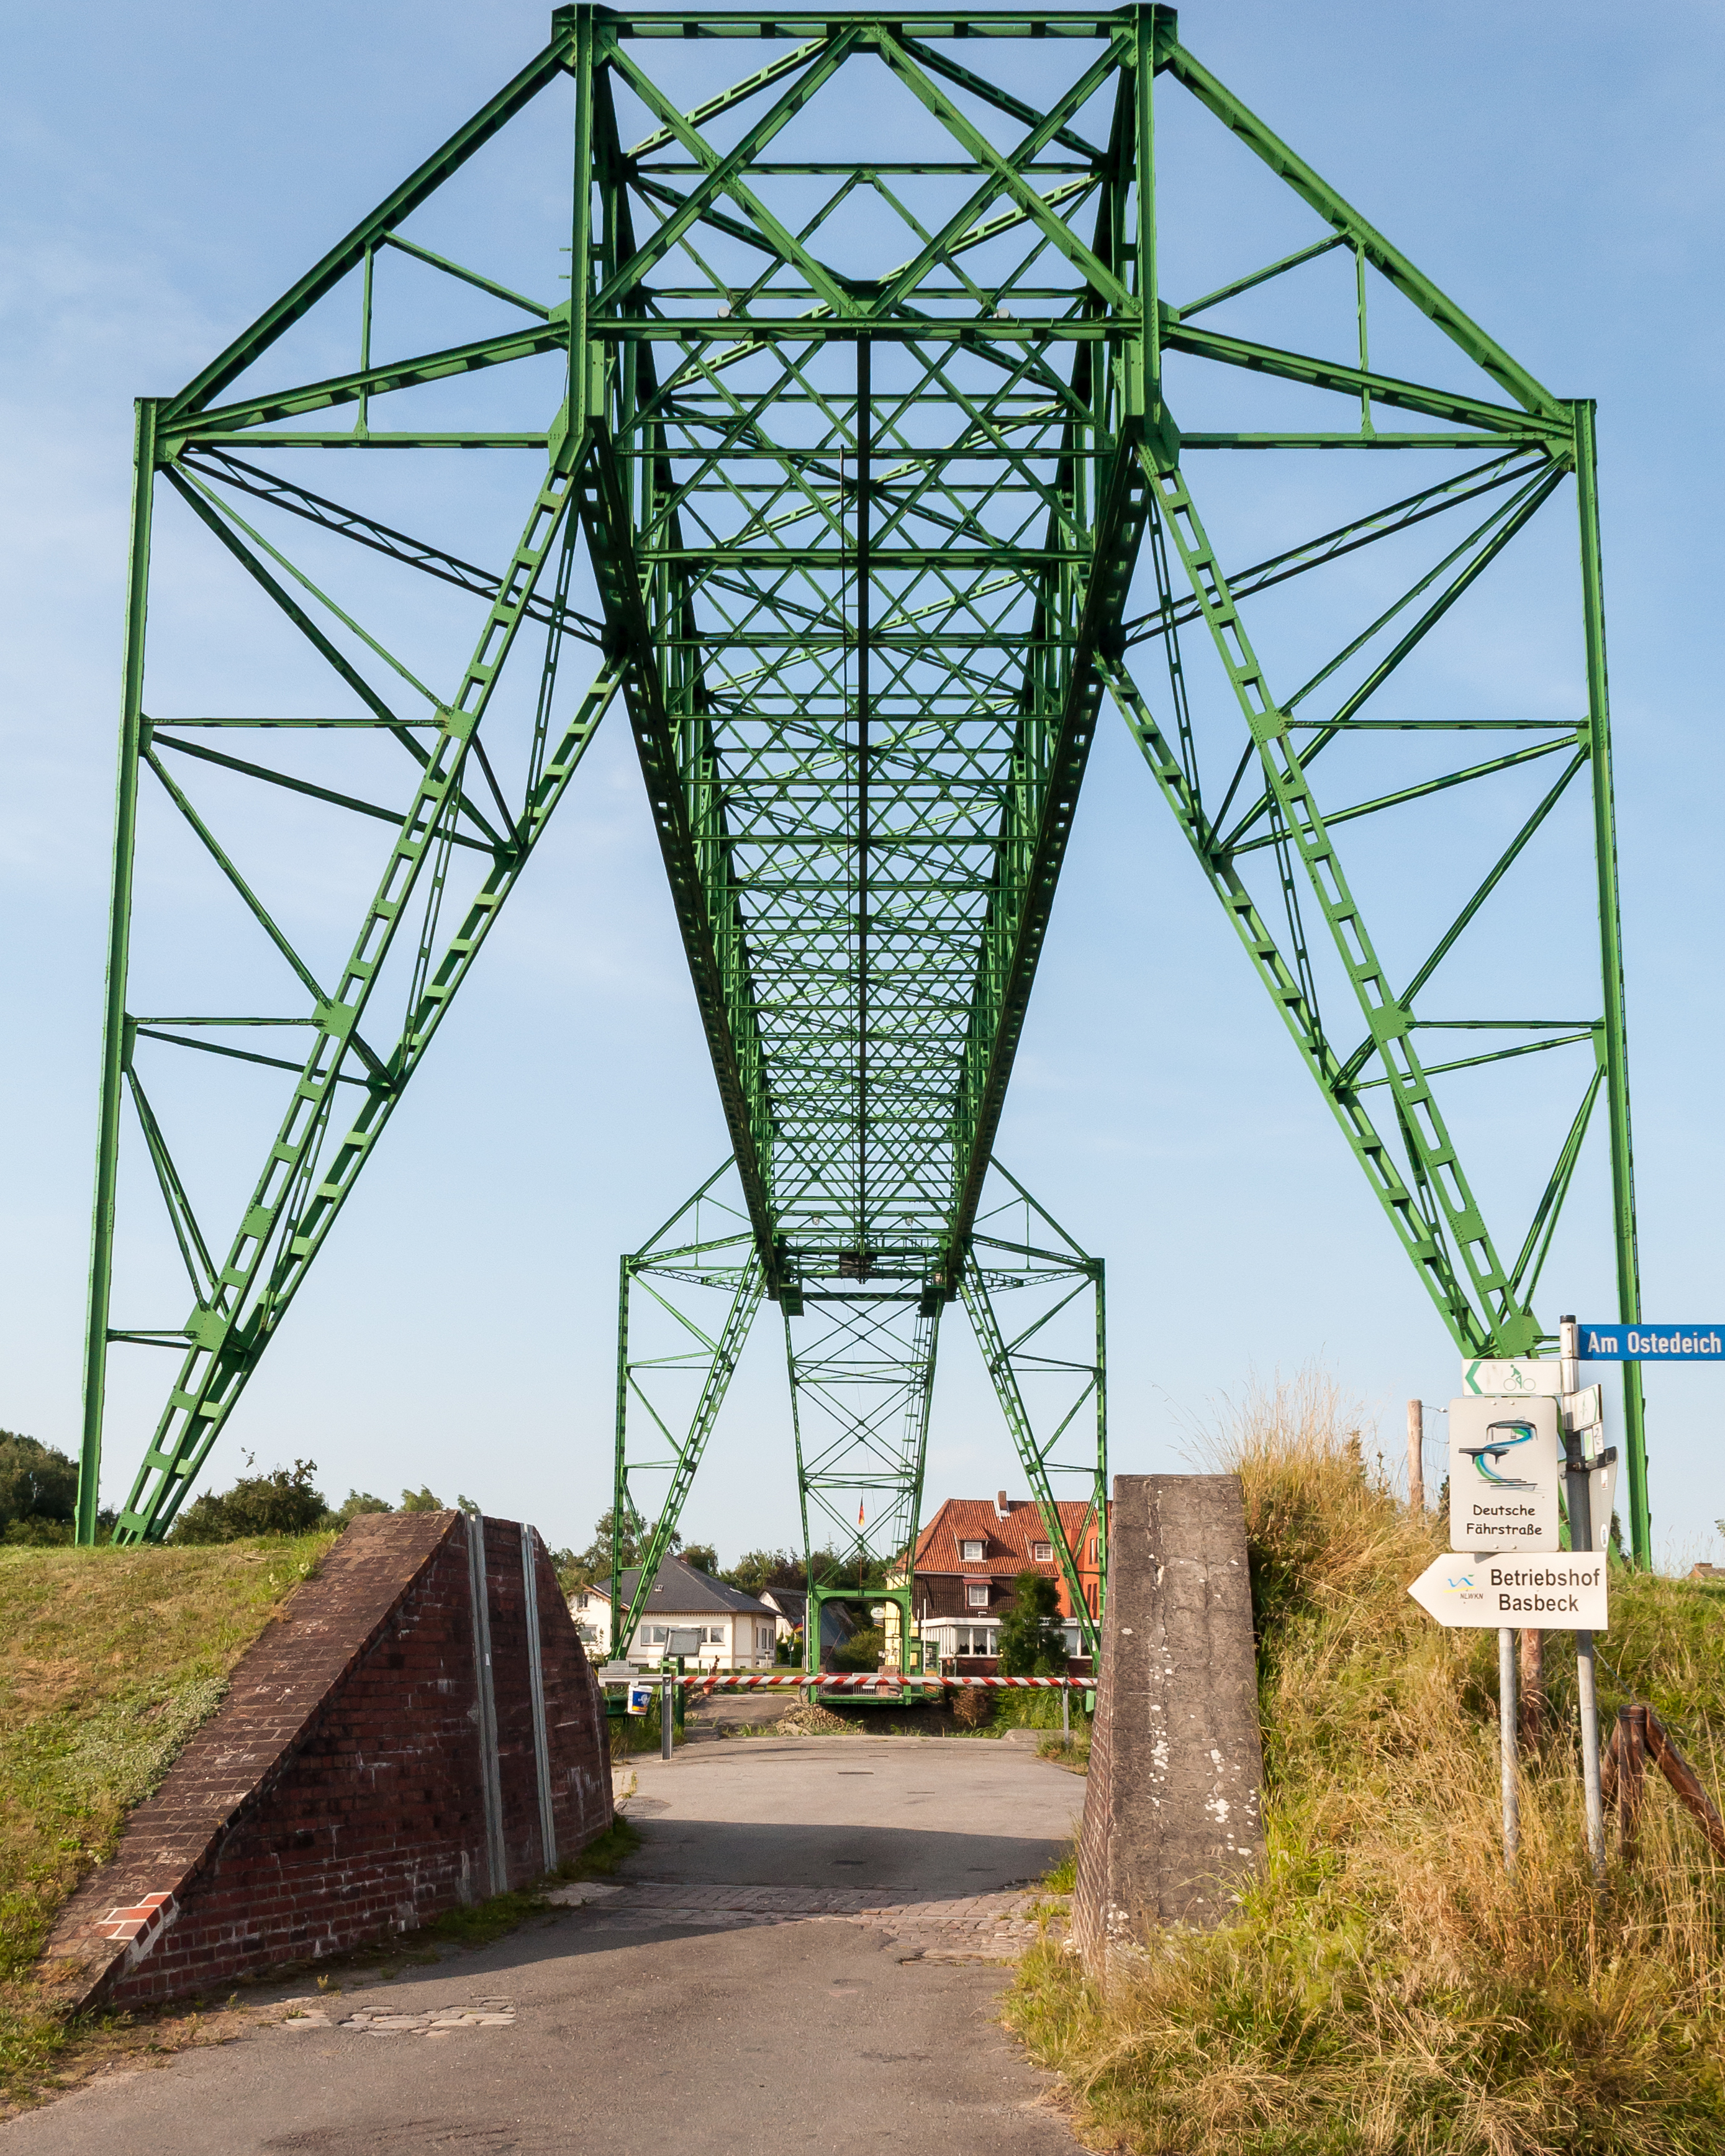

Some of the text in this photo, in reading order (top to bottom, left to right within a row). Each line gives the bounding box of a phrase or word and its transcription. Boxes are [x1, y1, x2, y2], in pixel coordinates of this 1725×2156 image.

[1588, 1331, 1722, 1354] Am Ostedeich
[1473, 1504, 1536, 1516] Deutsche
[1467, 1523, 1542, 1535] Fährstraße
[1491, 1568, 1600, 1586] Betriebshof
[1499, 1593, 1579, 1611] Basbeck
